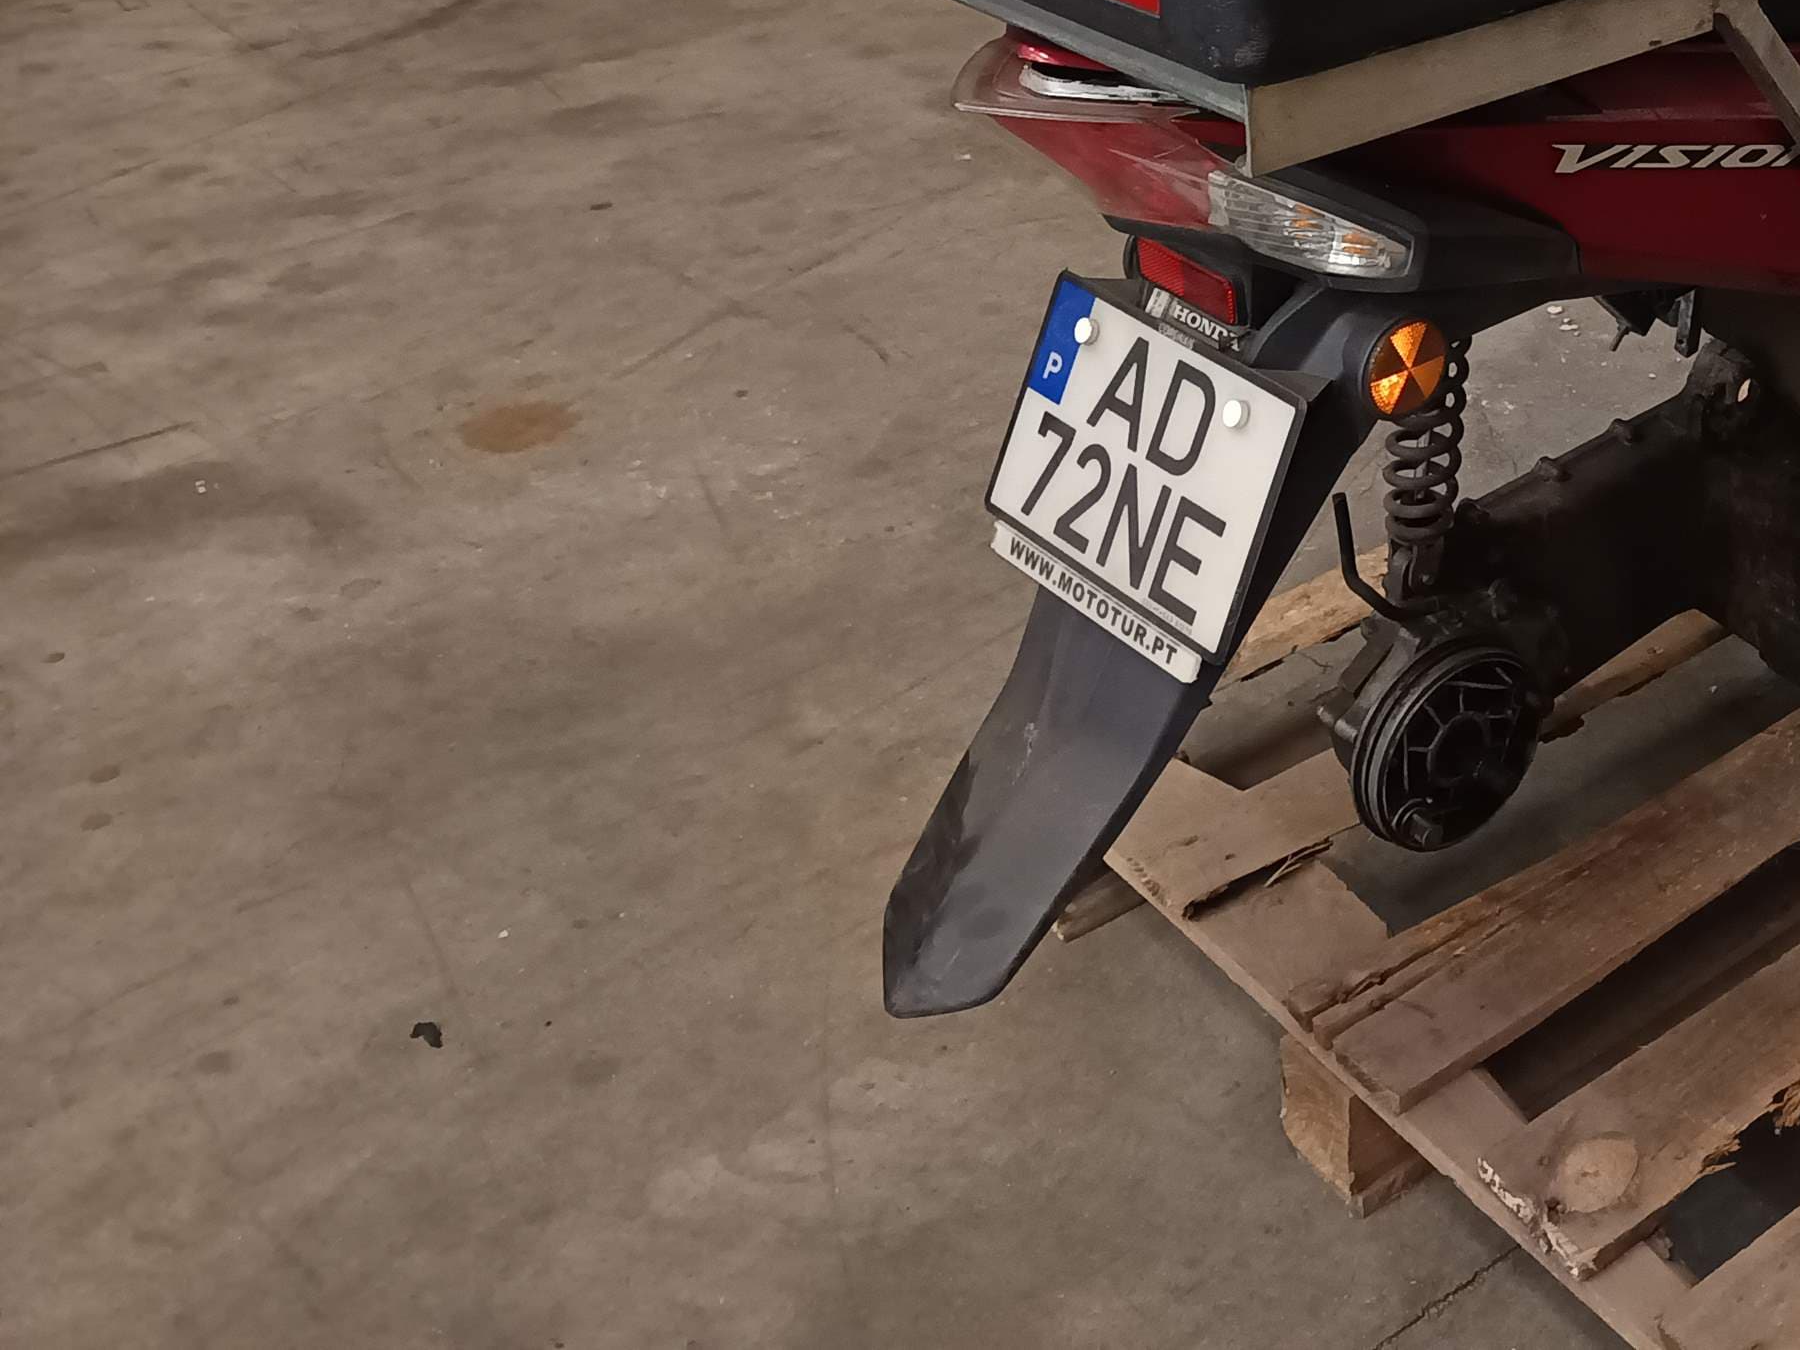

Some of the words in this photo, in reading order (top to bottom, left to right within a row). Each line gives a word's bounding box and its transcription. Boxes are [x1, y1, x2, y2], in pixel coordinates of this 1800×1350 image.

[1042, 350, 1064, 380] P
[1086, 336, 1217, 477] AD
[1020, 410, 1228, 627] 72NE
[1009, 535, 1178, 666] WWW.MOTOTUR.PT
